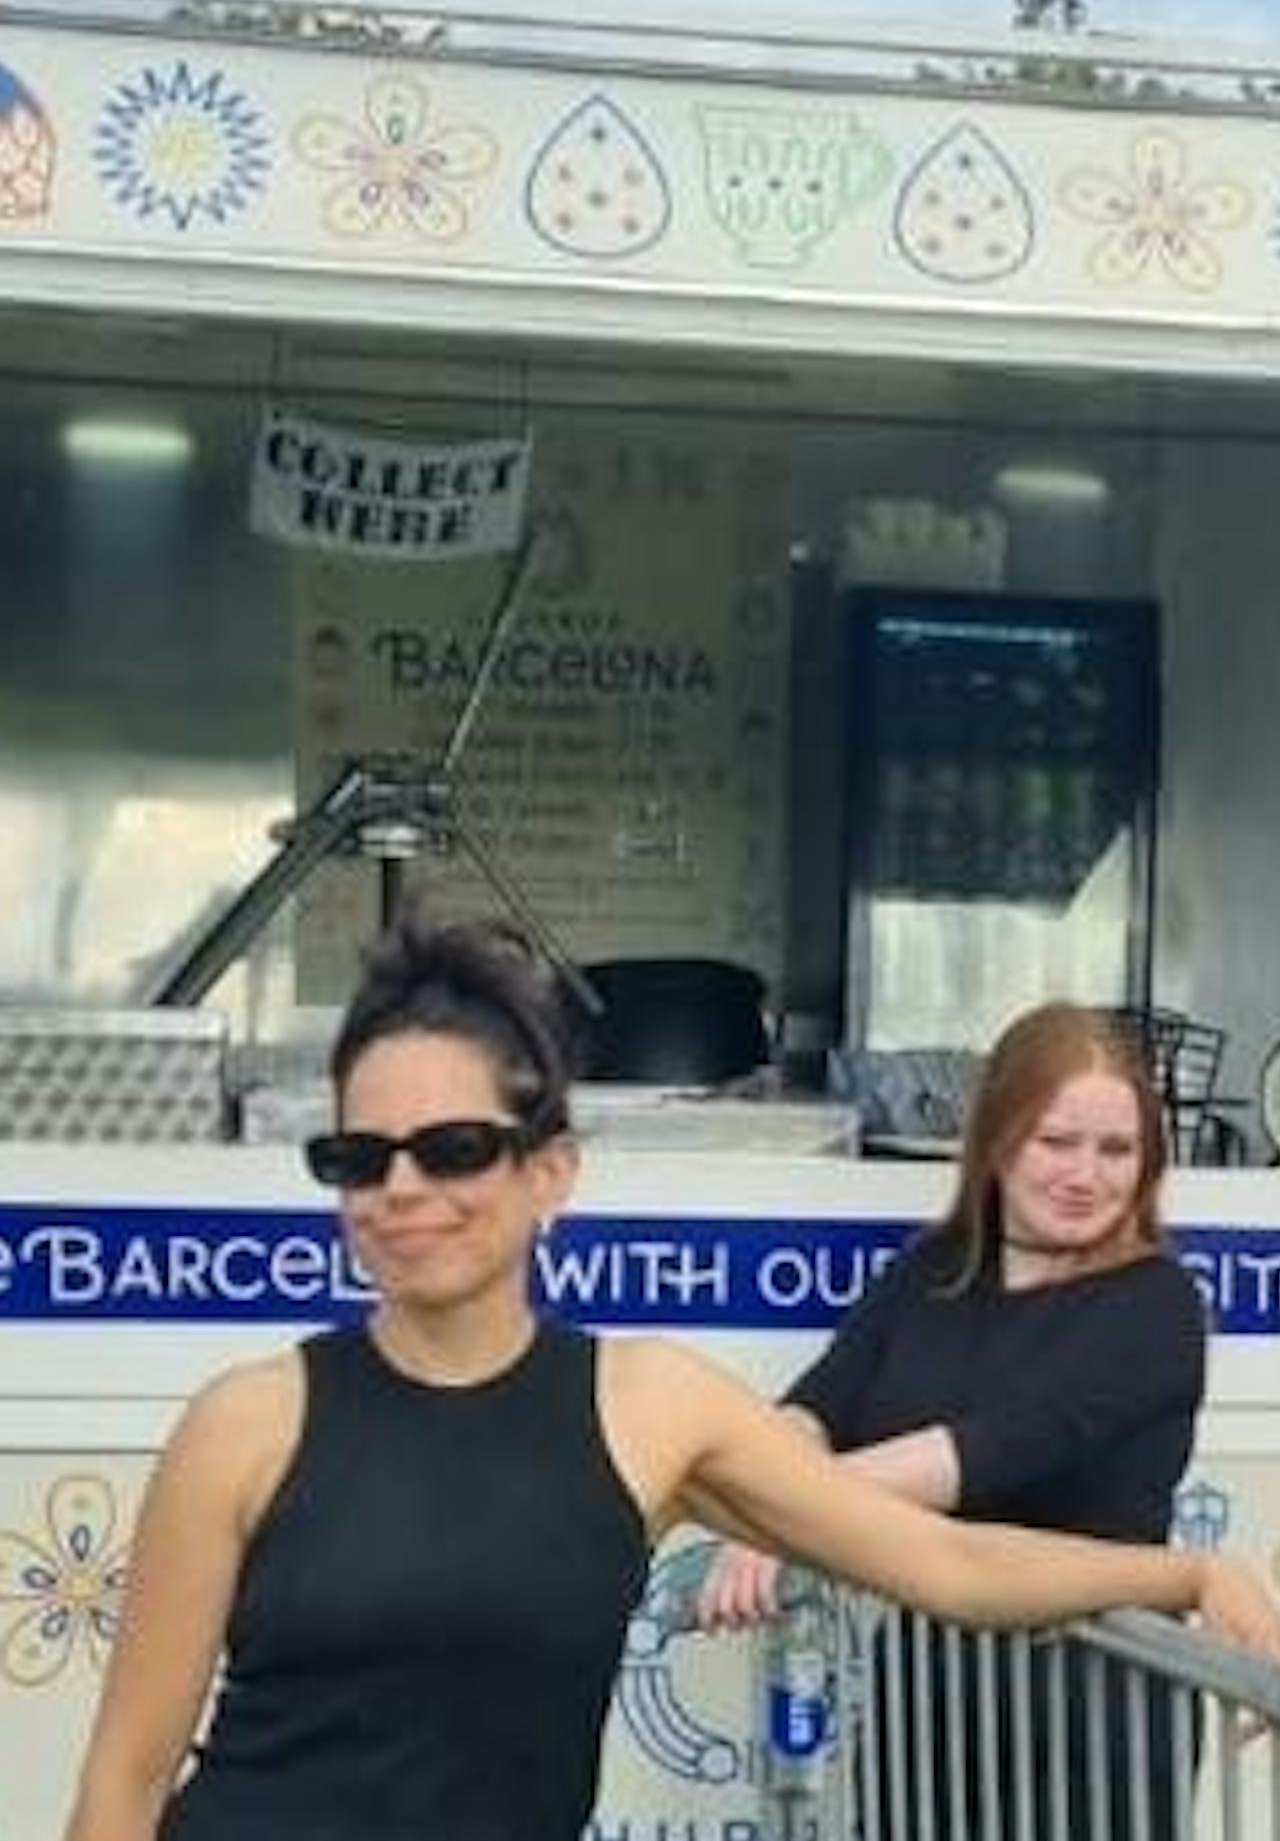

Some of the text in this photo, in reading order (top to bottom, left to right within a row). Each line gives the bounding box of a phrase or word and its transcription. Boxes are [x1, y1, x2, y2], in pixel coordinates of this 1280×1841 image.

[268, 429, 521, 497] COLLECT
[300, 488, 475, 543] HERE
[534, 1239, 730, 1305] WITH
